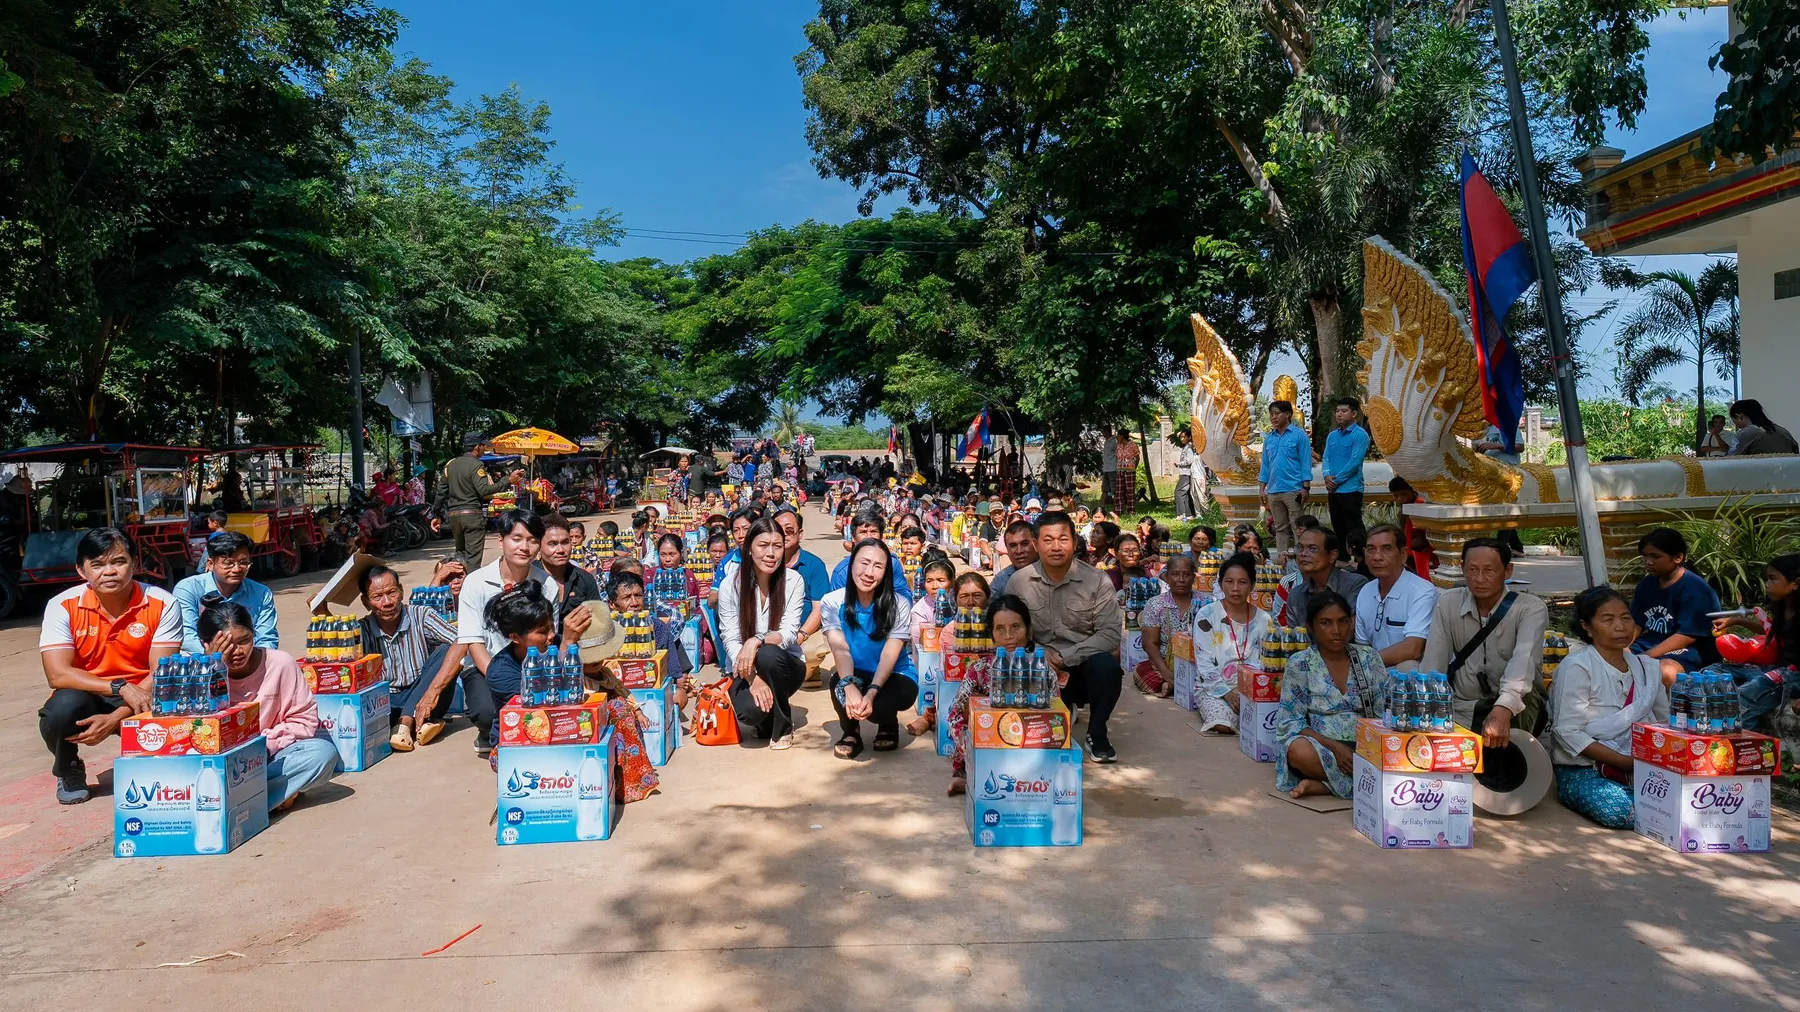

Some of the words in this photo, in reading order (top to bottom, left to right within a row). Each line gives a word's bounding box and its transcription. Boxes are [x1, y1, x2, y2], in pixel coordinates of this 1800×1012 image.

[140, 781, 191, 802] Vital
[1391, 779, 1445, 811] Baby
[1690, 783, 1744, 815] Baby
[507, 811, 522, 821] NSF
[984, 813, 999, 823] NSF
[126, 822, 141, 832] NSF
[1409, 818, 1423, 827] Baby
[1709, 822, 1723, 831] Baby
[1723, 821, 1743, 829] Formula
